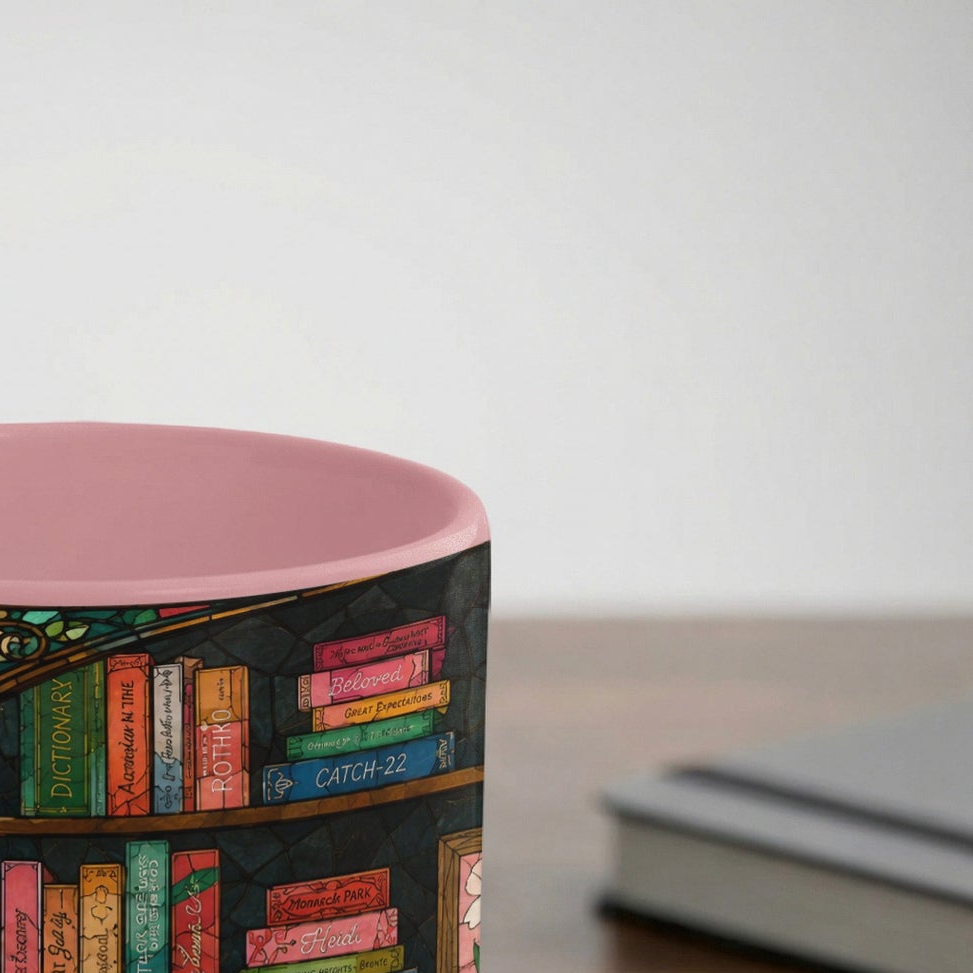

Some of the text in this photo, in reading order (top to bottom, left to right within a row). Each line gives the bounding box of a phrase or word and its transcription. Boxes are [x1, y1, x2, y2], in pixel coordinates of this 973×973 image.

[328, 664, 404, 697] Beloved
[50, 678, 73, 798] DICTIONARY
[211, 708, 233, 793] ROTHKO
[315, 752, 408, 789] CATCH-22
[343, 887, 372, 903] PARK
[300, 923, 363, 955] Heidi
